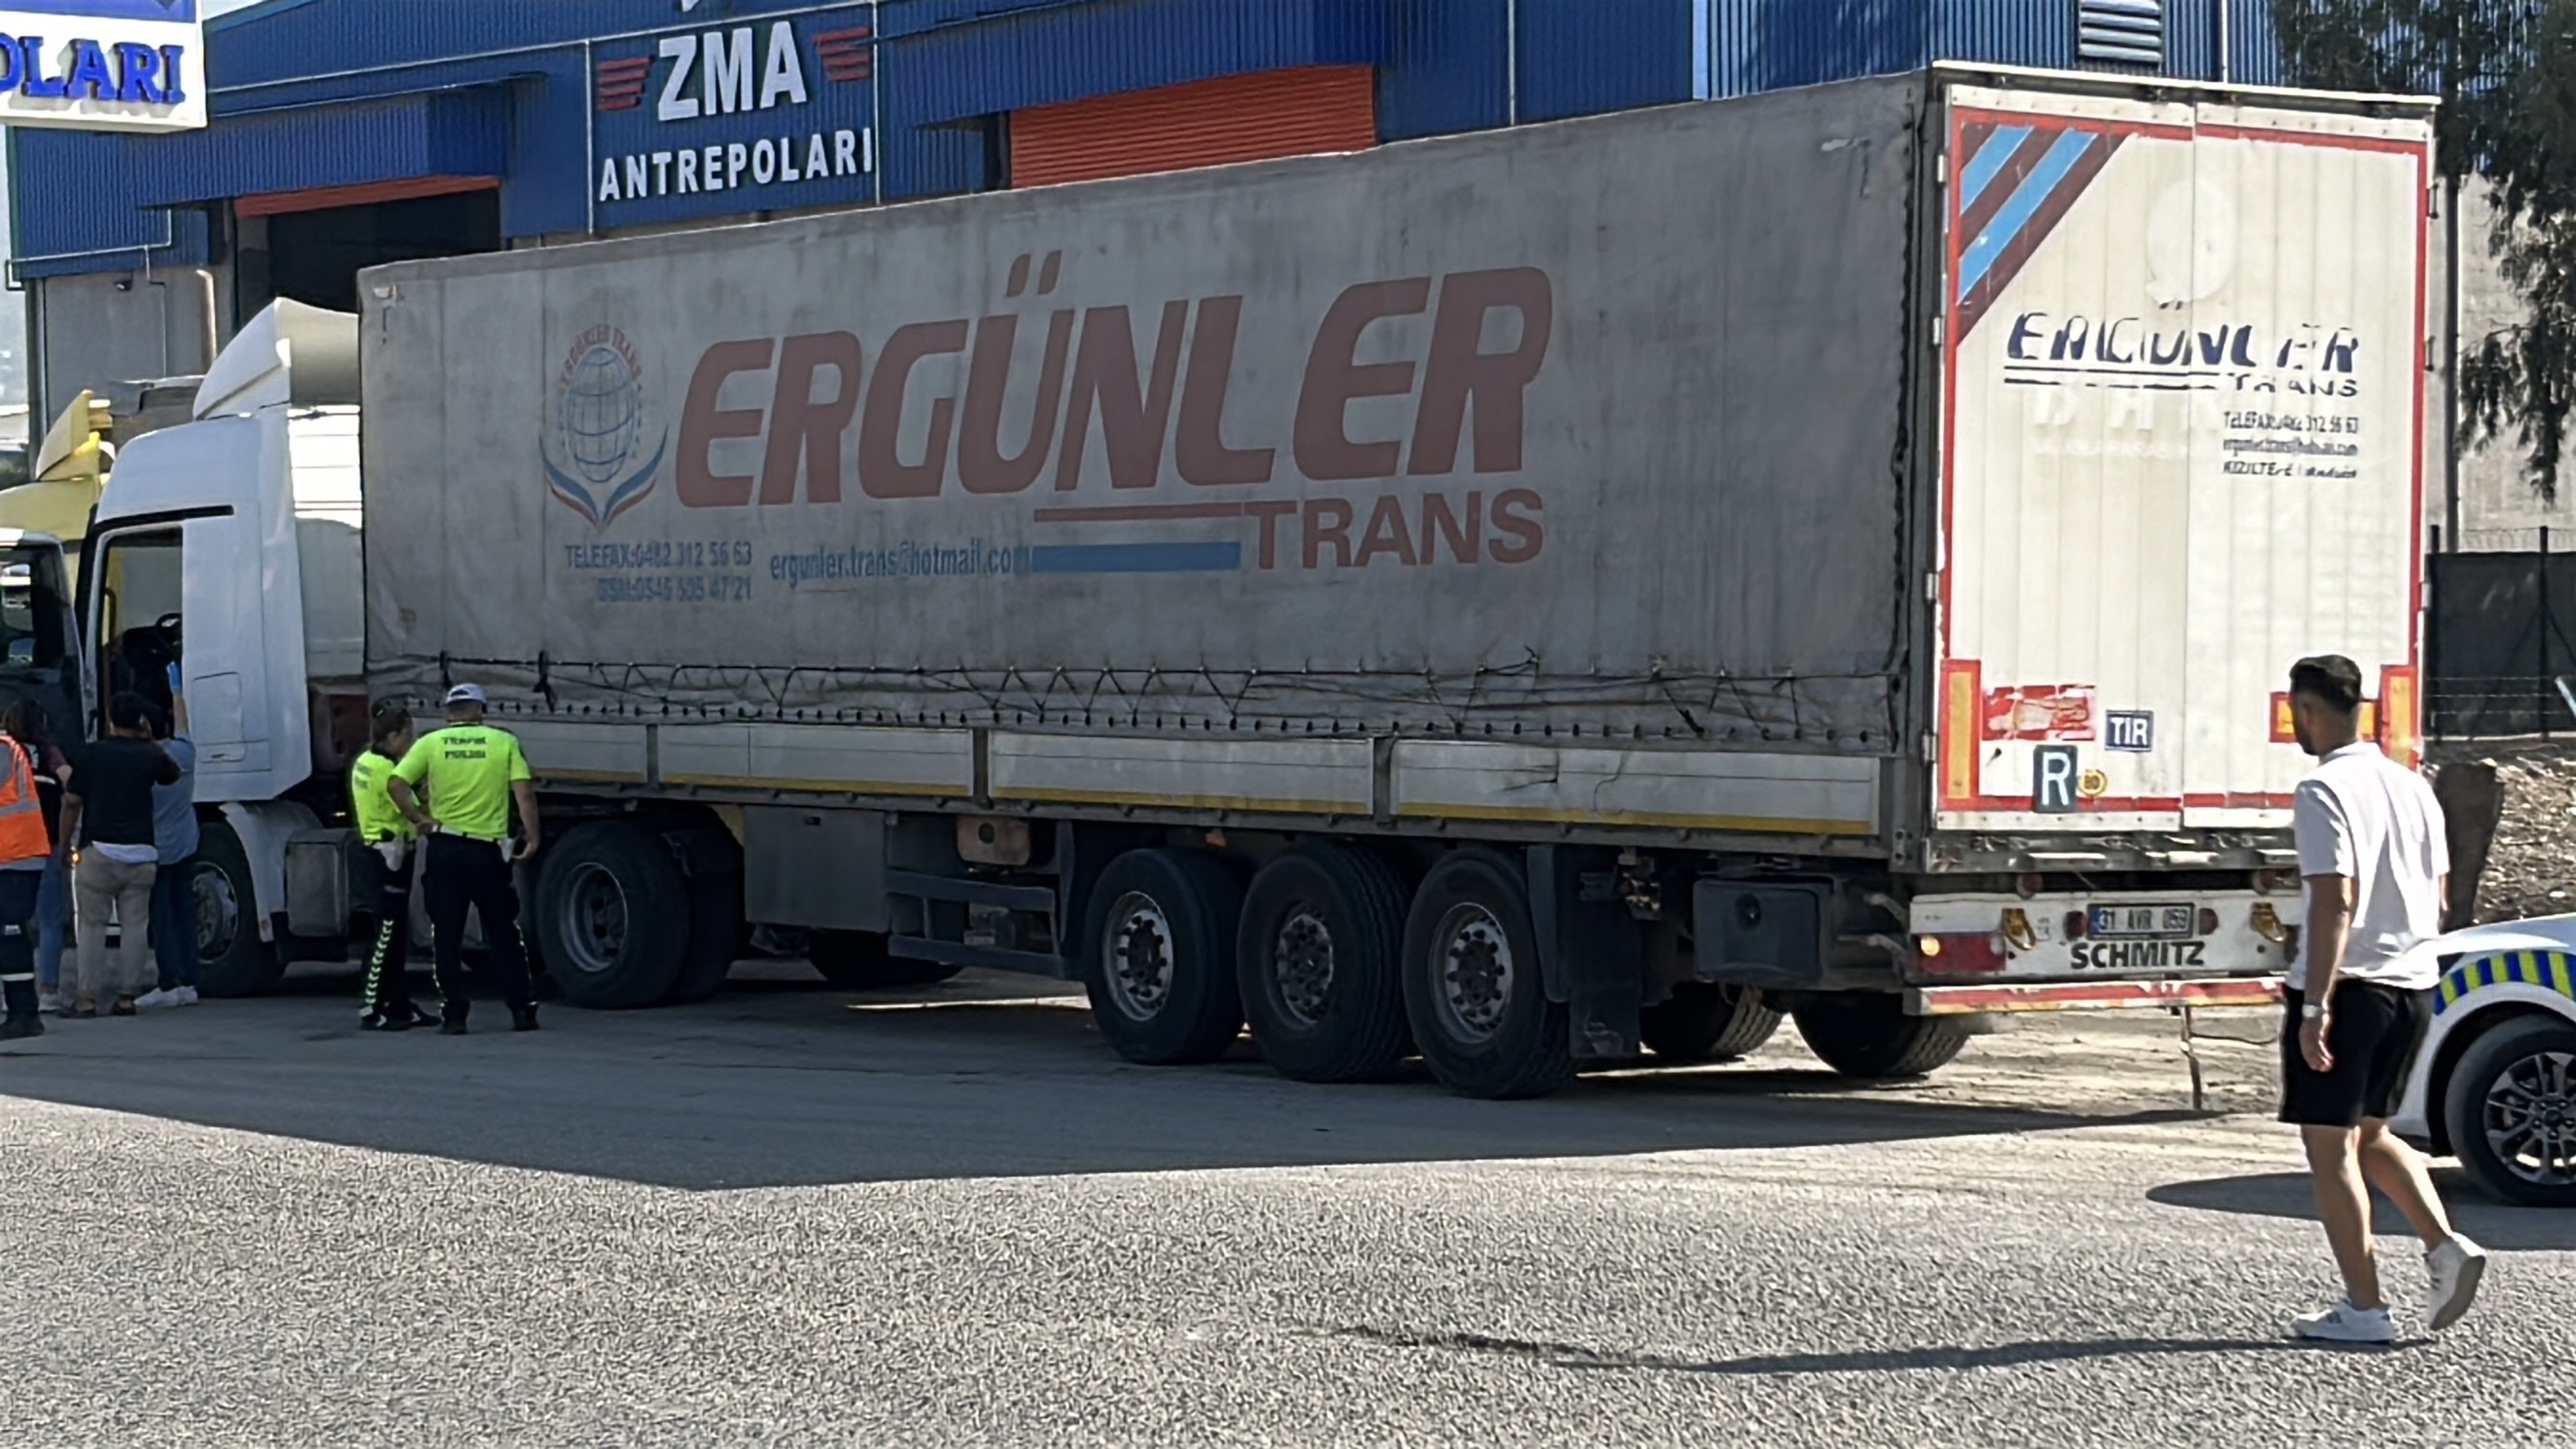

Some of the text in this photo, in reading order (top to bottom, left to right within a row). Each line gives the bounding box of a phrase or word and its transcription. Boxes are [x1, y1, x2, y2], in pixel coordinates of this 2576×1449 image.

[659, 20, 806, 121] ZMA
[599, 127, 873, 201] ANTREPOLARI
[675, 250, 1552, 508] ERGÜNLER
[1243, 488, 1546, 570] TRANS
[2111, 717, 2148, 745] TIR
[2042, 751, 2071, 806] R
[2070, 941, 2206, 970] SCHMITZ
